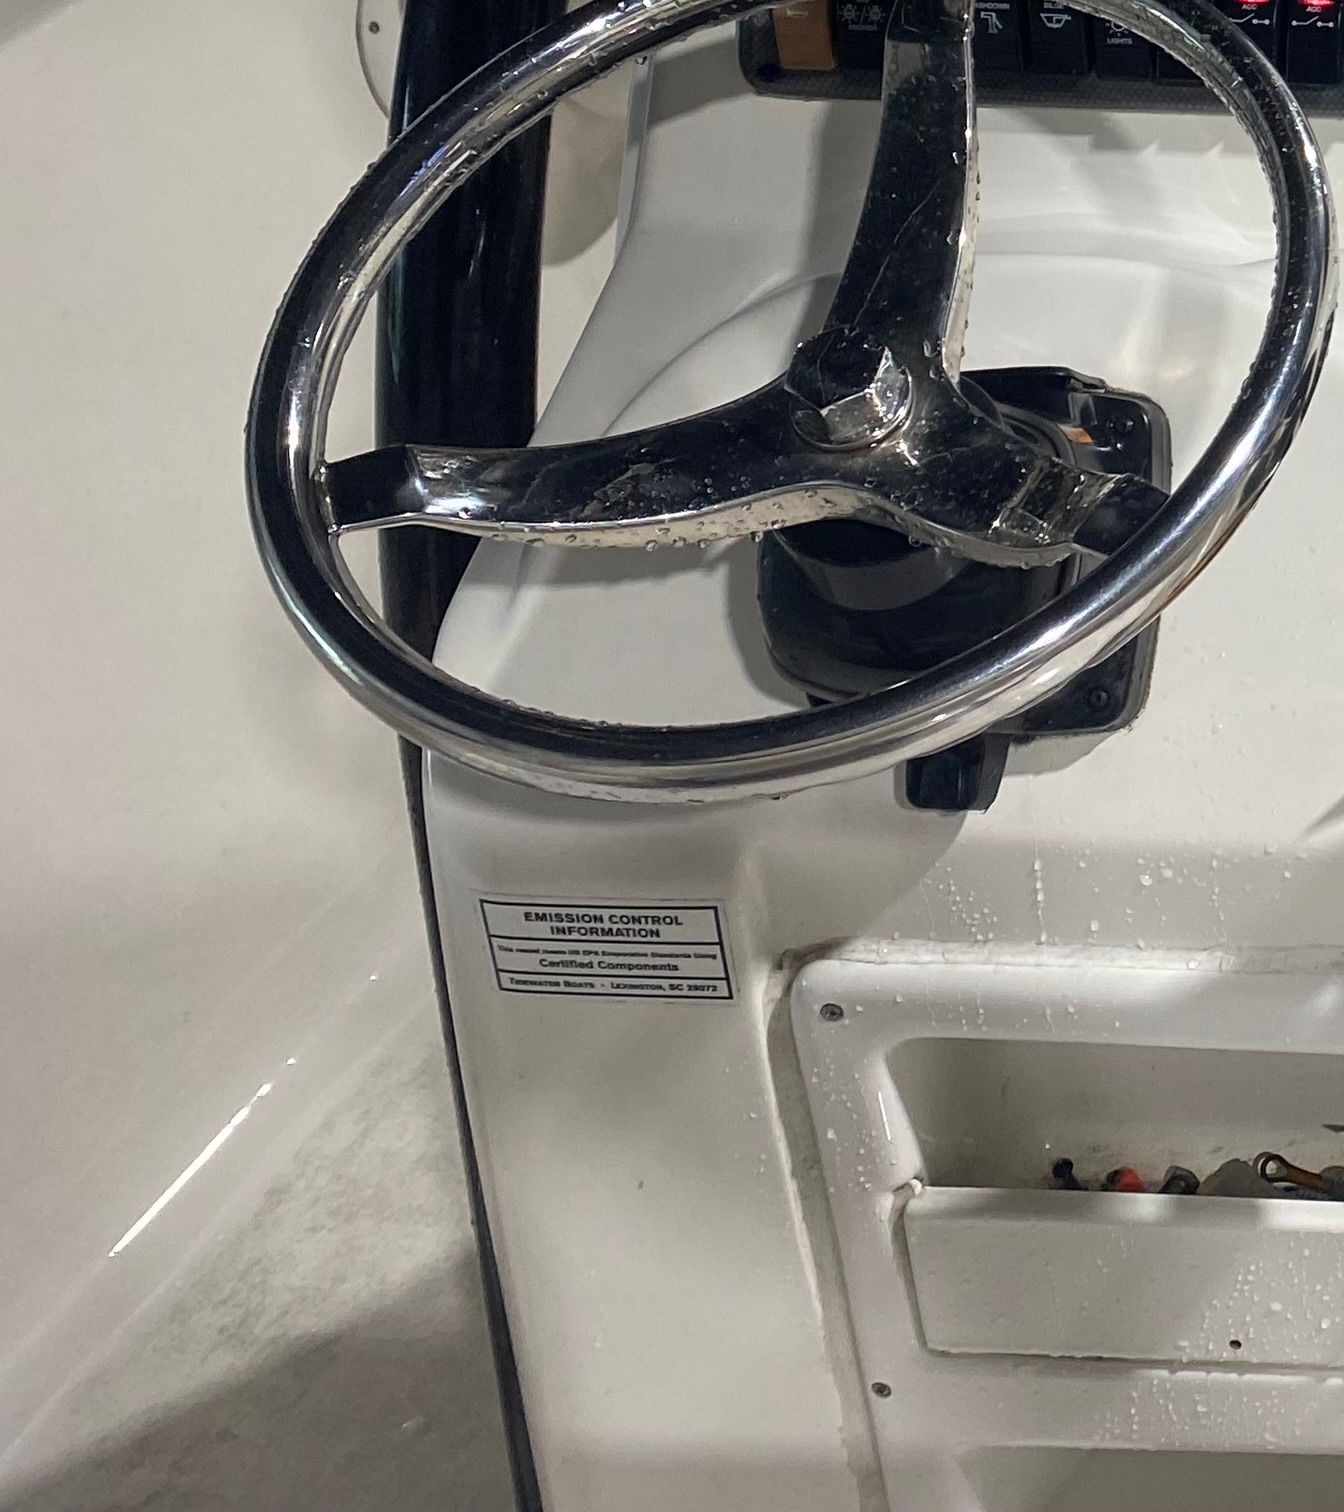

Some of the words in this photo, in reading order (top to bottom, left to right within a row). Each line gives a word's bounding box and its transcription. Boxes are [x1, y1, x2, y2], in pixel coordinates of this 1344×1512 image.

[524, 911, 604, 925] EMISSION
[609, 914, 683, 926] CONTROL
[550, 925, 661, 938] INFORMATION
[539, 958, 594, 969] Certified
[597, 960, 679, 971] Components
